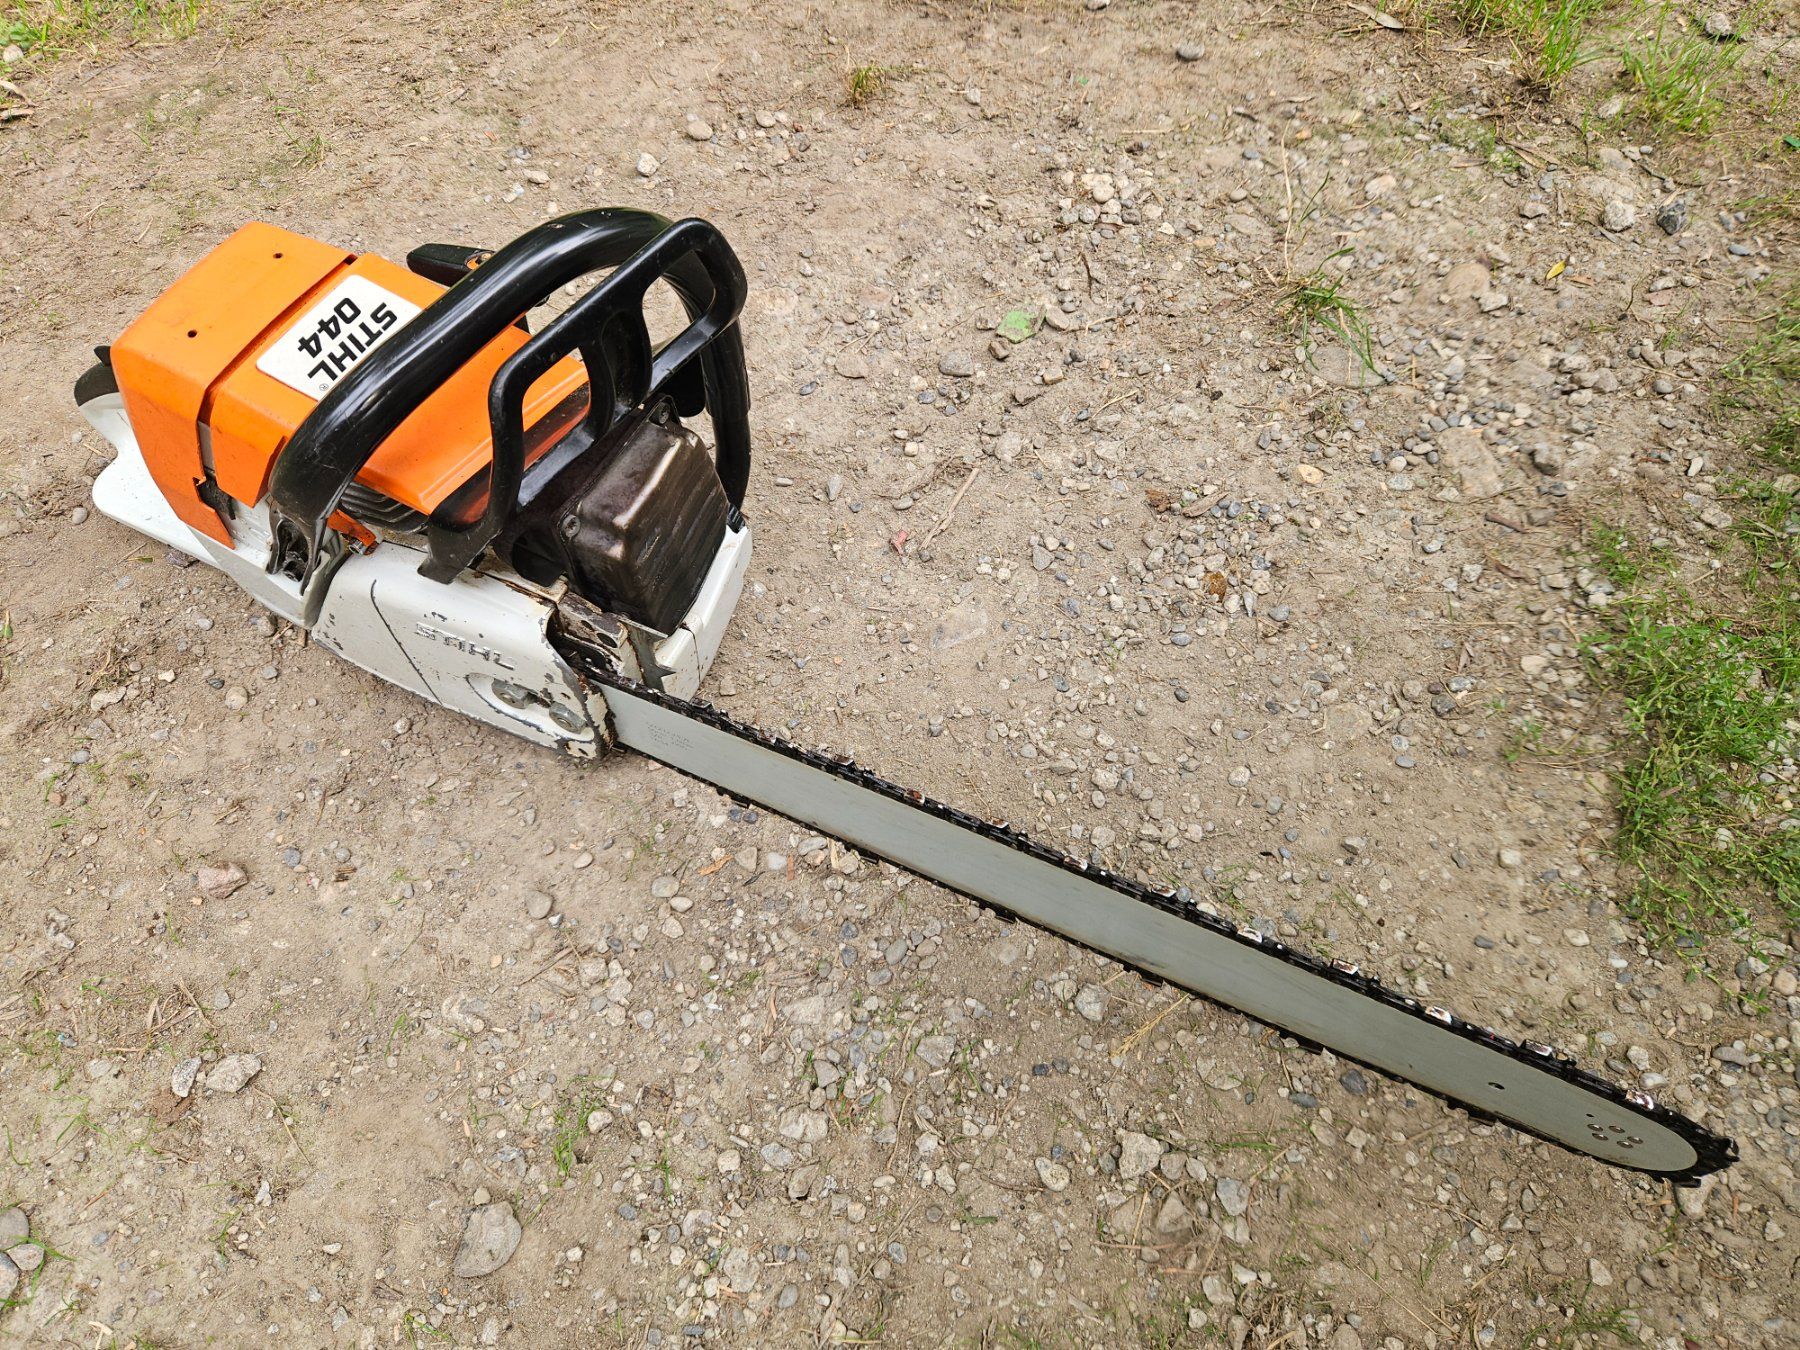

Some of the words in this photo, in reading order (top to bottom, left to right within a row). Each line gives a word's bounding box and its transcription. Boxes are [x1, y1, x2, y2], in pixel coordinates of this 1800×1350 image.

[297, 297, 361, 358] 044
[307, 302, 398, 381] STIHL
[415, 622, 515, 671] STIHL
